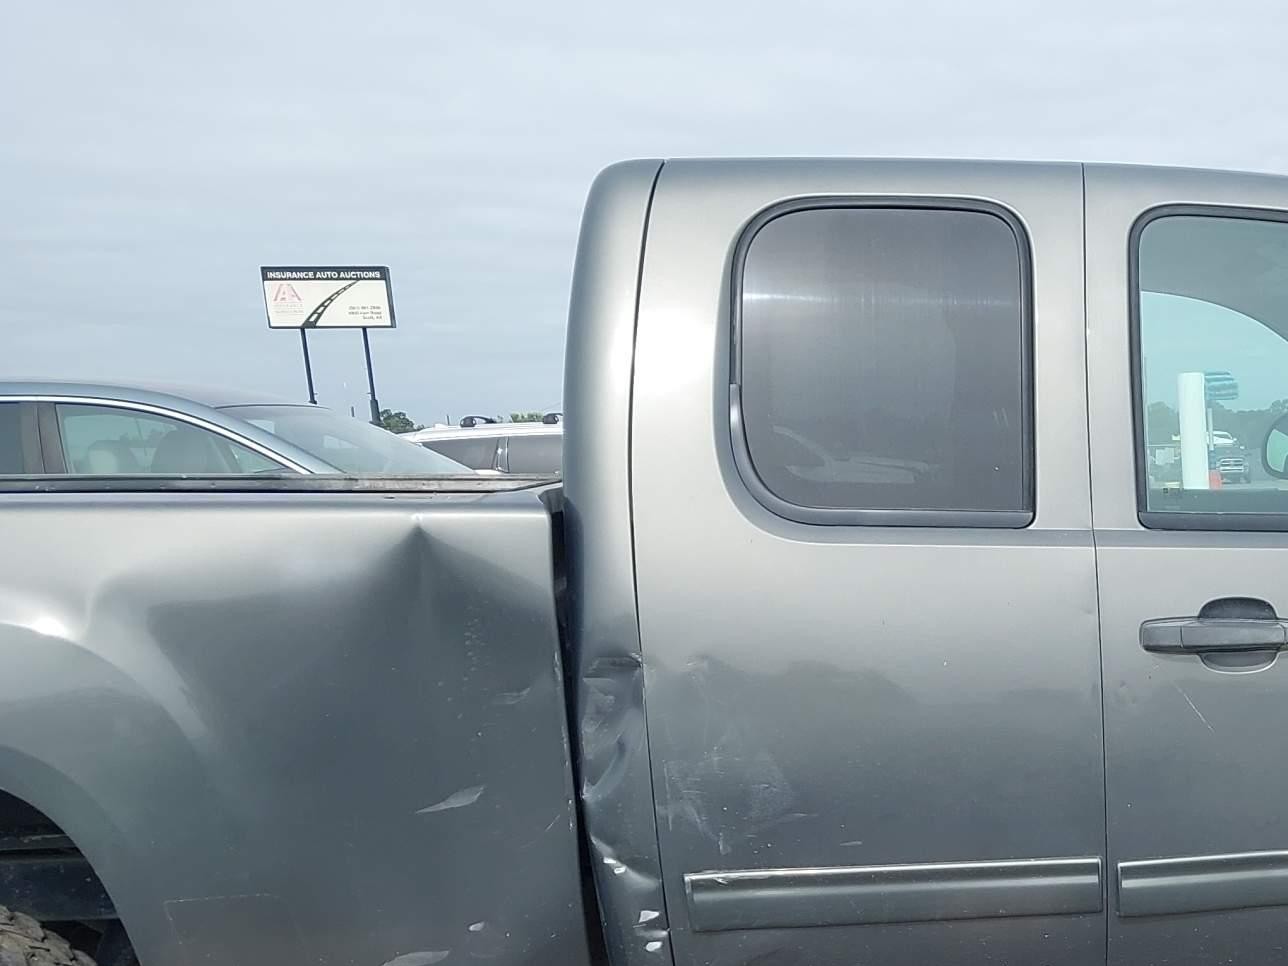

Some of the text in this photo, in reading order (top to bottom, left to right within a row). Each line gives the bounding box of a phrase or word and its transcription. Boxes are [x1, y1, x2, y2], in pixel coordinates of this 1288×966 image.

[267, 271, 380, 279] INSURANCE AUTO AUCTIONS
